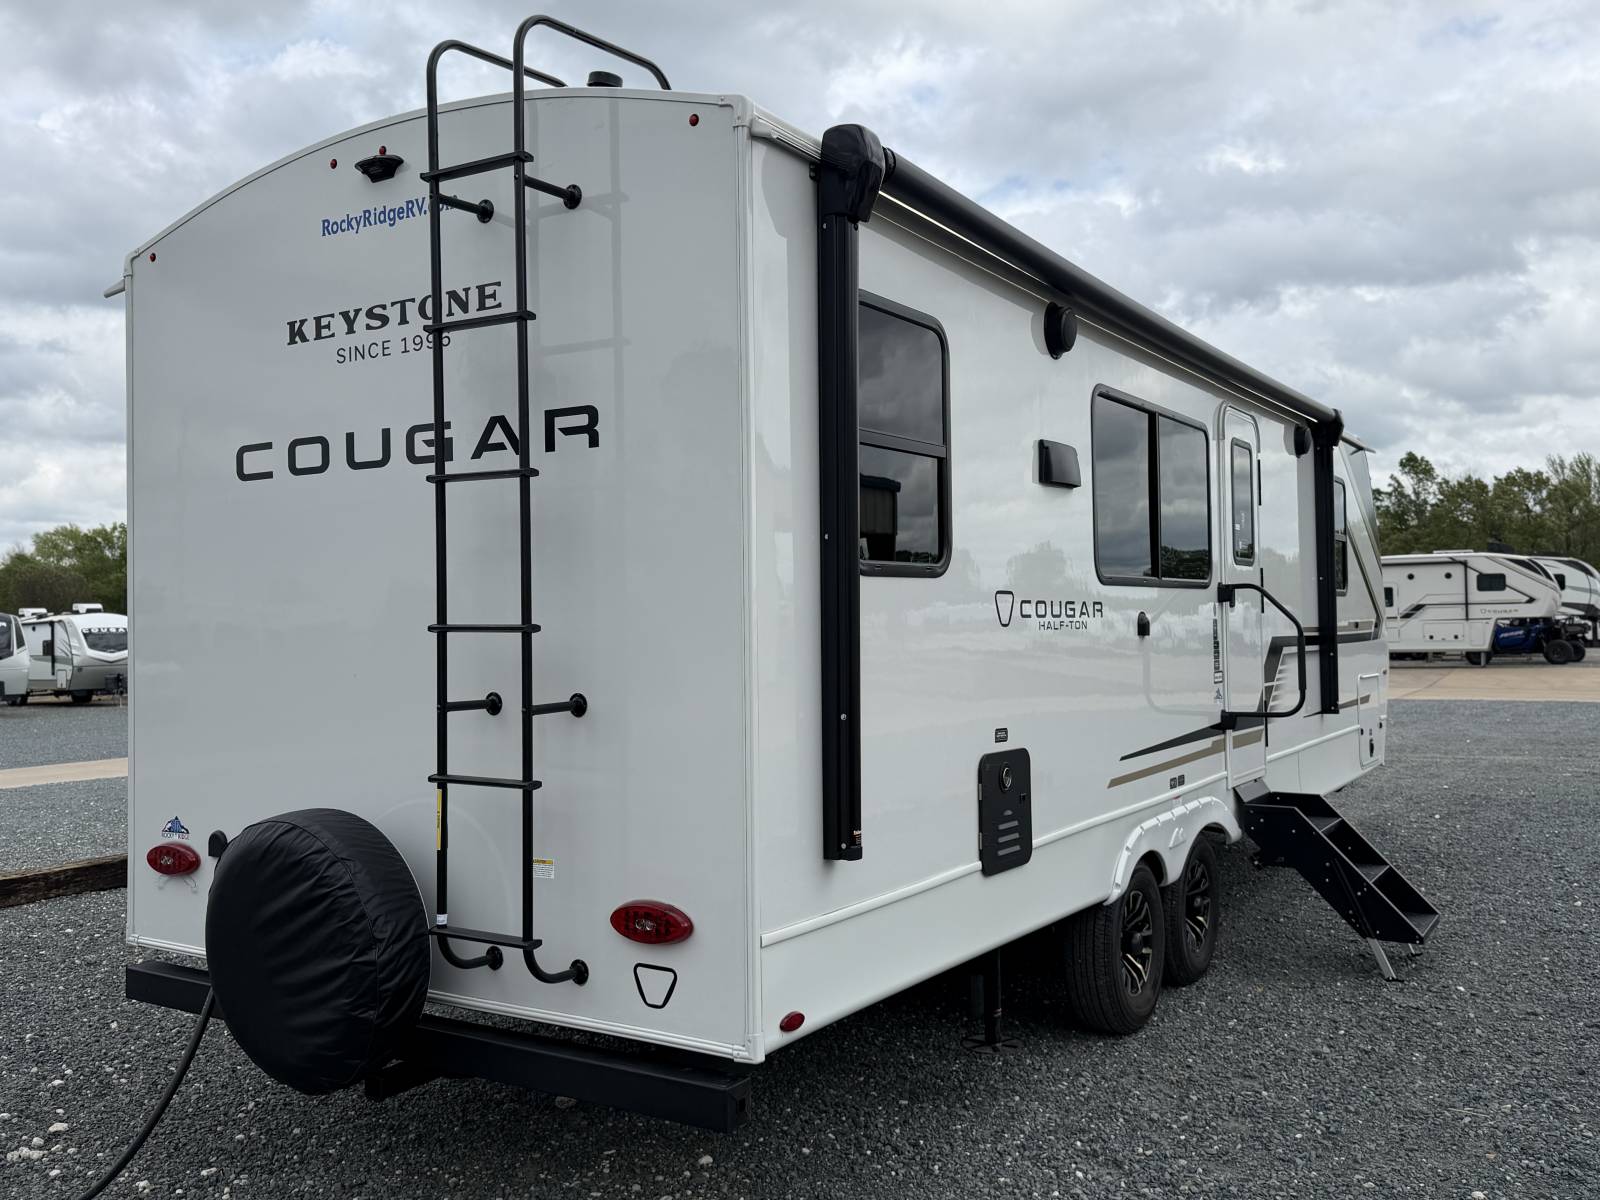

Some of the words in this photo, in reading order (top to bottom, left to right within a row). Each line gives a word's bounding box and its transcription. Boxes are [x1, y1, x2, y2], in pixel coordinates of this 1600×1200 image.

[321, 196, 457, 236] RockyRidgeRV.
[287, 281, 502, 345] KEYSTONE
[336, 339, 392, 364] SINCE
[236, 404, 600, 482] COUGAR
[1020, 600, 1104, 618] COUGAR
[1038, 621, 1088, 630] HALF-TON
